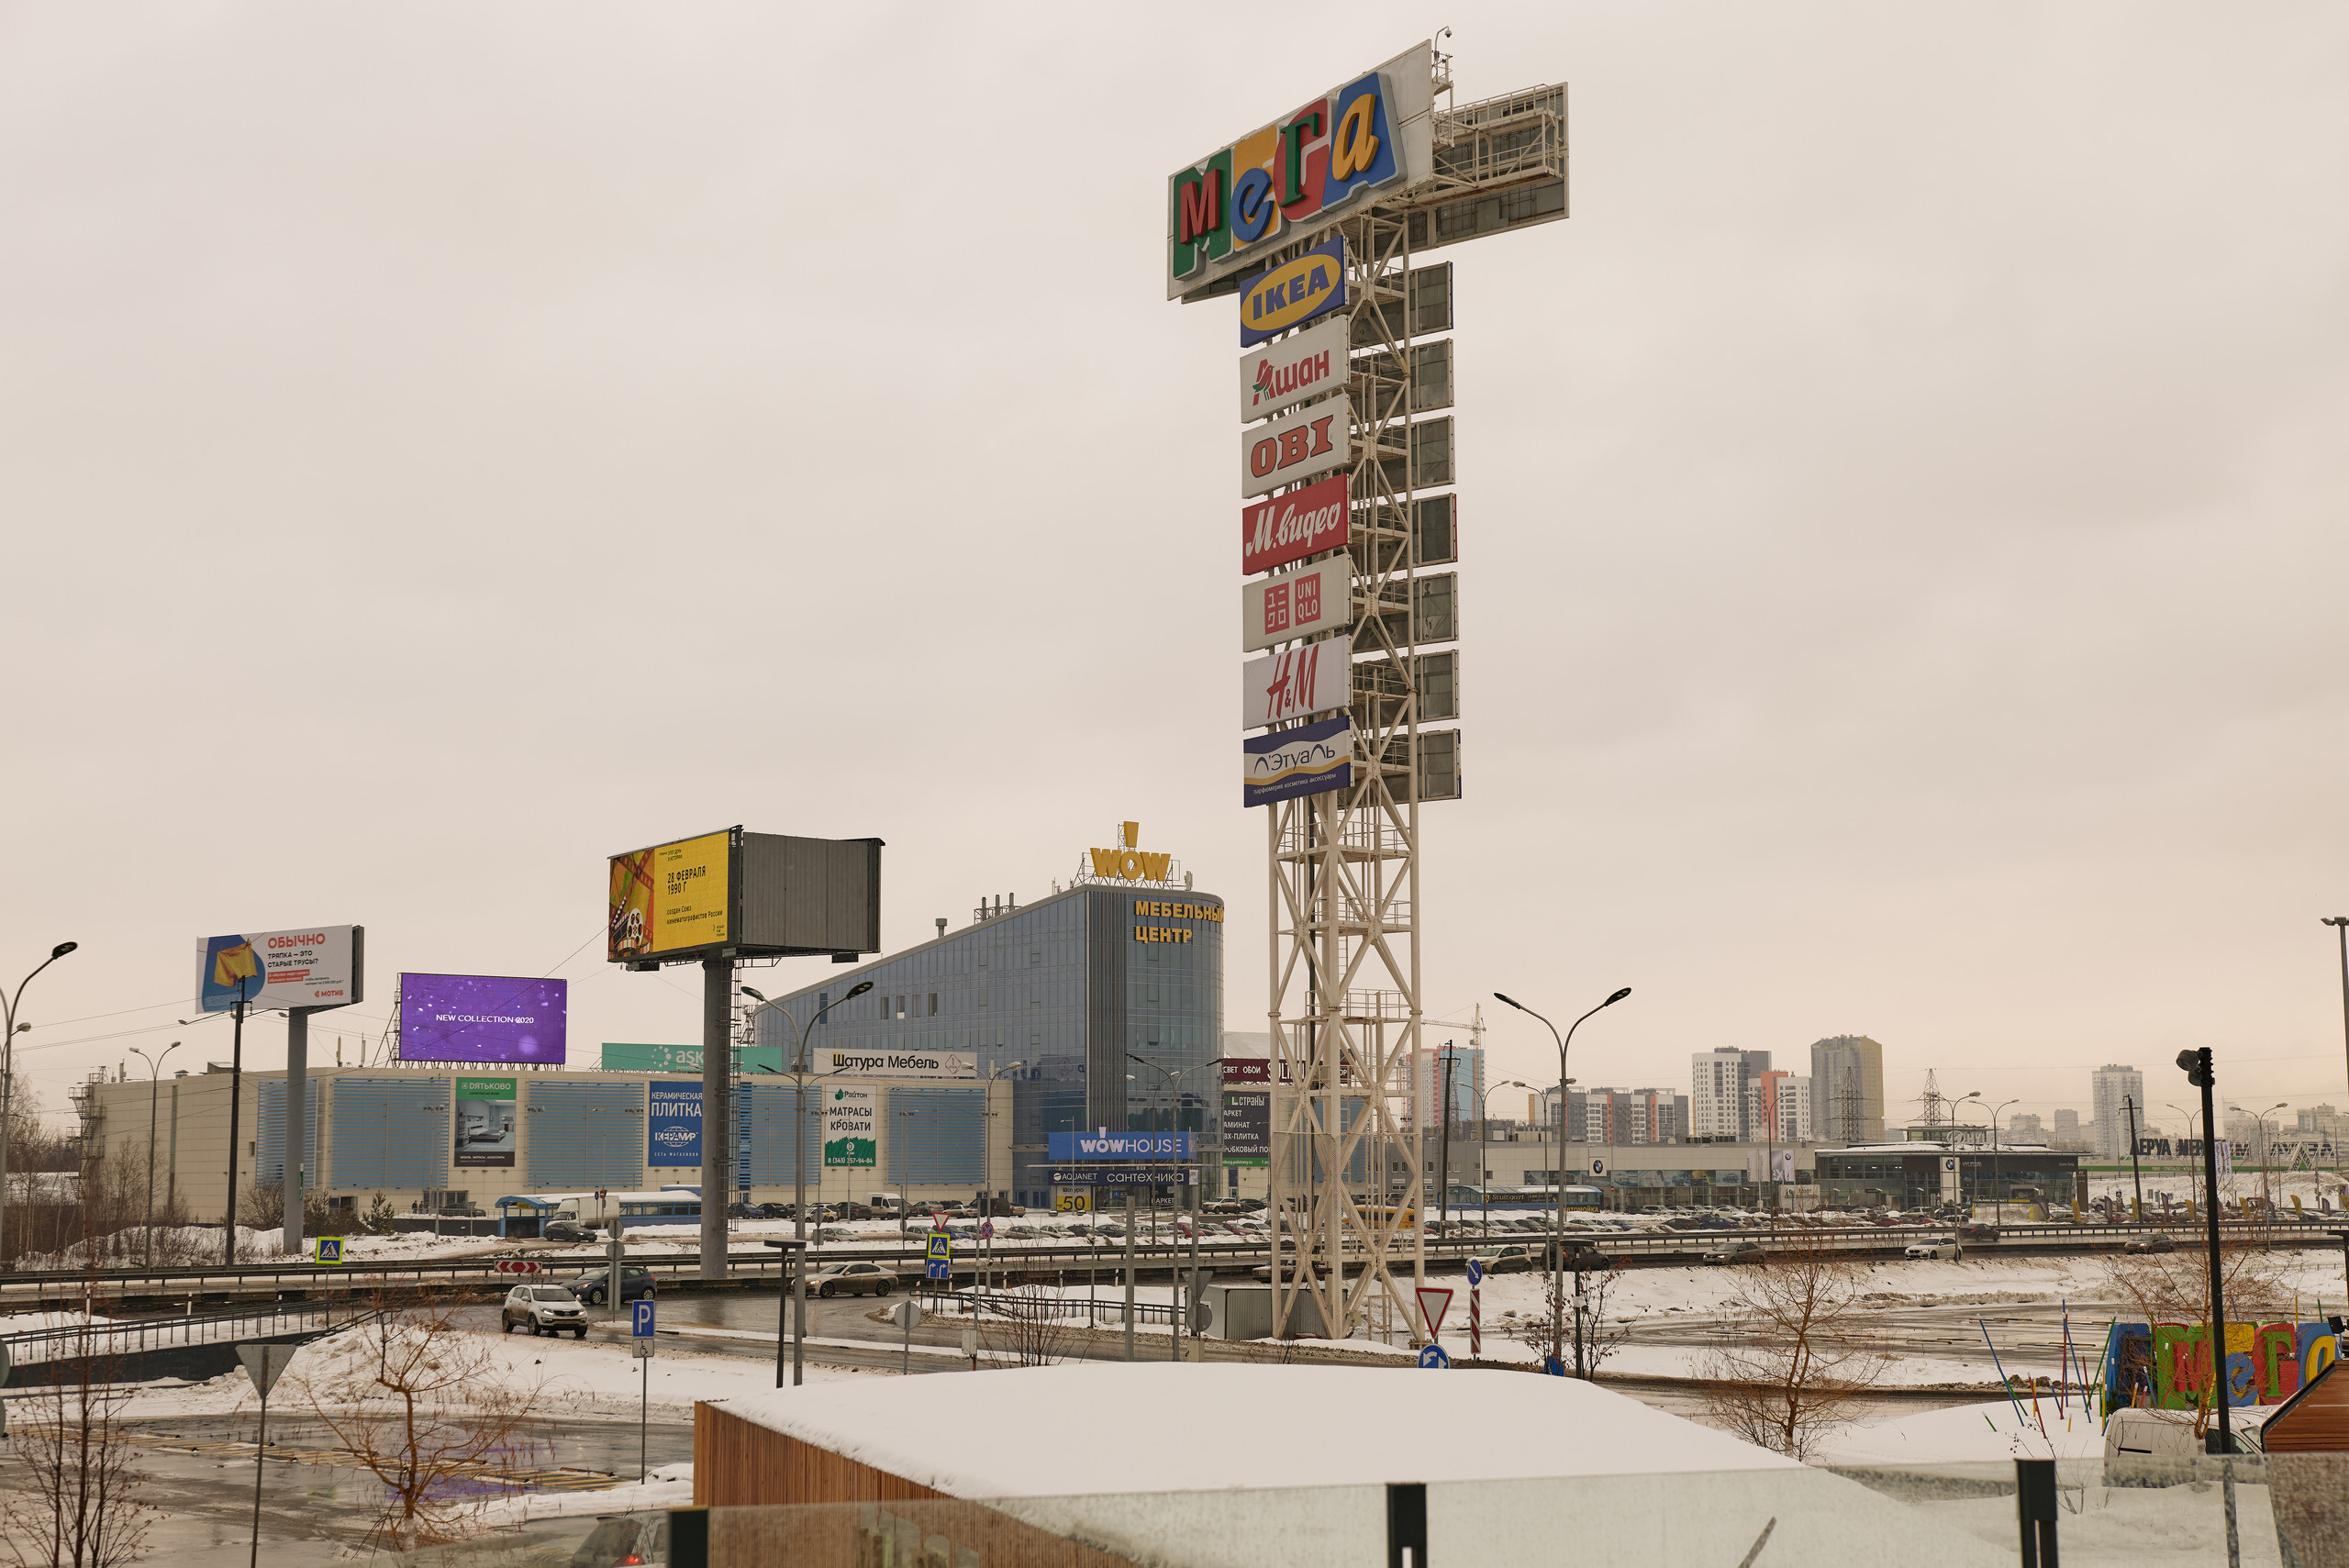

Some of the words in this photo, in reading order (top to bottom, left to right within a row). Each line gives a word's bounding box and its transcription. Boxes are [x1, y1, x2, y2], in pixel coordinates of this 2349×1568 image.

[1252, 263, 1330, 321] IKEA
[1250, 414, 1334, 478] OBI
[1245, 501, 1341, 558] М.видео
[1297, 578, 1317, 599] UNI
[1297, 597, 1319, 618] QLO
[1266, 643, 1319, 719] H&M
[1284, 779, 1308, 788] косметика
[1089, 847, 1171, 881] WOW
[668, 872, 675, 883] 28
[676, 866, 706, 881] ФЕВРАЛЯ
[668, 882, 681, 895] 1990
[1135, 901, 1225, 923] МЕБЕЛЬНЫЙ
[268, 933, 325, 949] ОБЫЧНО
[1135, 926, 1193, 944] ЦЕНТР
[436, 1014, 456, 1022] NEW
[458, 1015, 514, 1024] COLLECTION
[832, 1054, 884, 1071] Шатура
[888, 1055, 939, 1069] Мебель
[1243, 1065, 1261, 1074] ОБОИ
[652, 1092, 703, 1100] КЕРАМИЧЕСКАЯ
[651, 1102, 702, 1117] ПЛИТКА
[829, 1106, 872, 1117] МАТРАСЫ
[831, 1121, 871, 1131] КРОВАТИ
[655, 1132, 696, 1141] КЕРАМИР
[1080, 1139, 1182, 1153] WOWHOUSE
[2130, 1138, 2171, 1155] ЛЕРУА
[2299, 1147, 2312, 1171] MERL
